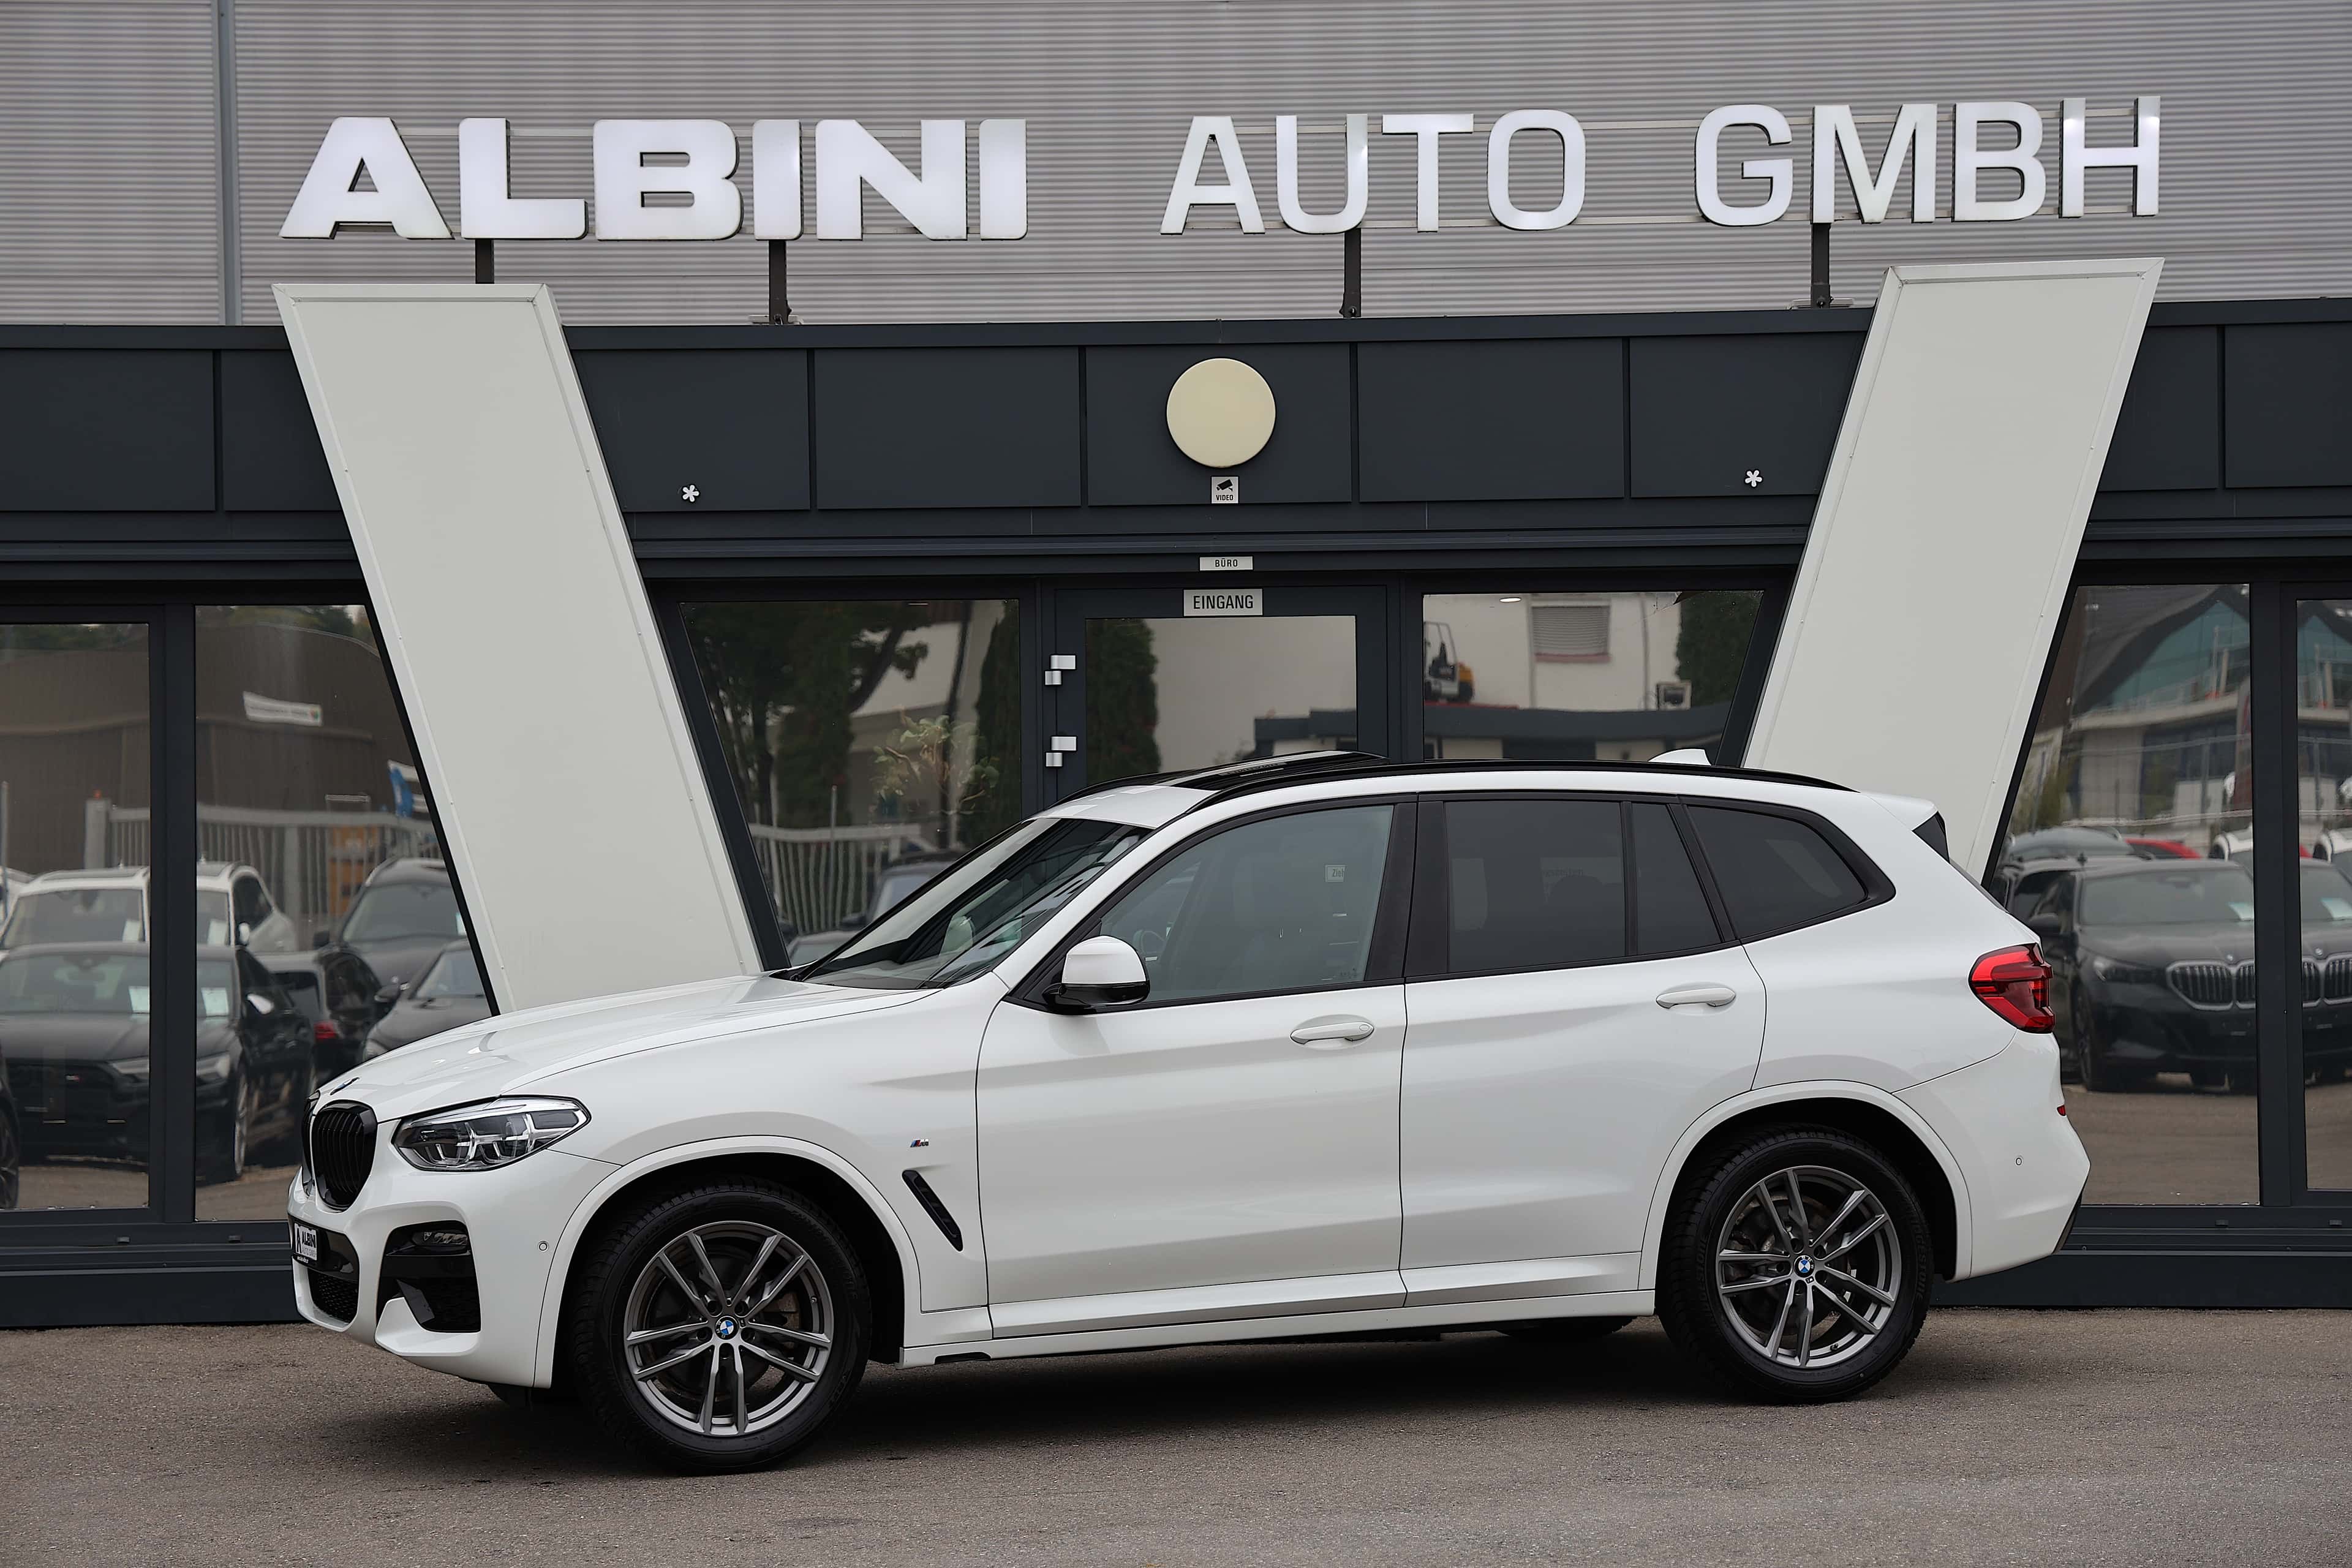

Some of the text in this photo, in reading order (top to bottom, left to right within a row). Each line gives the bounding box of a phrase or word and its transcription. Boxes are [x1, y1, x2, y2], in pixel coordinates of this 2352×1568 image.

[279, 96, 2162, 241] ALBINI AUTO GMBH
[1215, 557, 1238, 567] BÜRO
[1193, 595, 1253, 609] EINGANG
